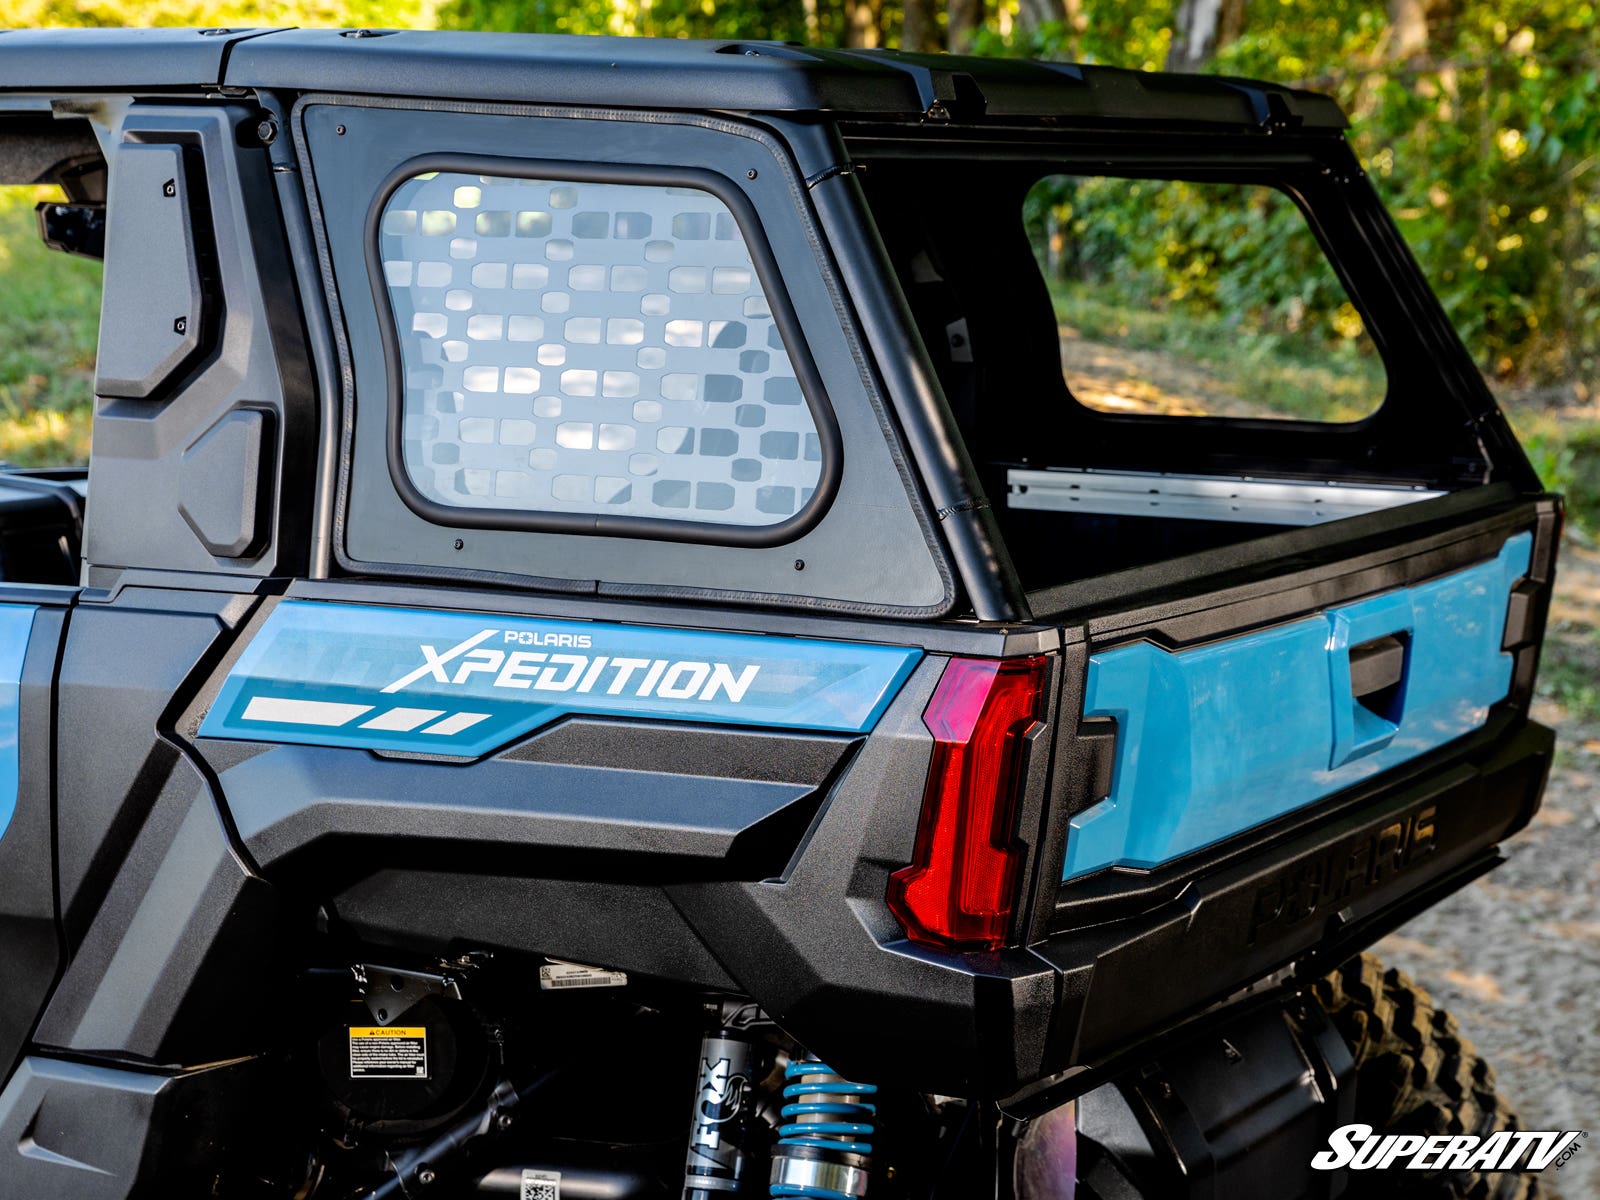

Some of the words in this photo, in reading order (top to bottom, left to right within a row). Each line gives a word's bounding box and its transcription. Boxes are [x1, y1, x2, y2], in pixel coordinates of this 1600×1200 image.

[379, 629, 761, 702] XPEDITION
[503, 630, 592, 648] POLARIS
[691, 1057, 738, 1149] FOX
